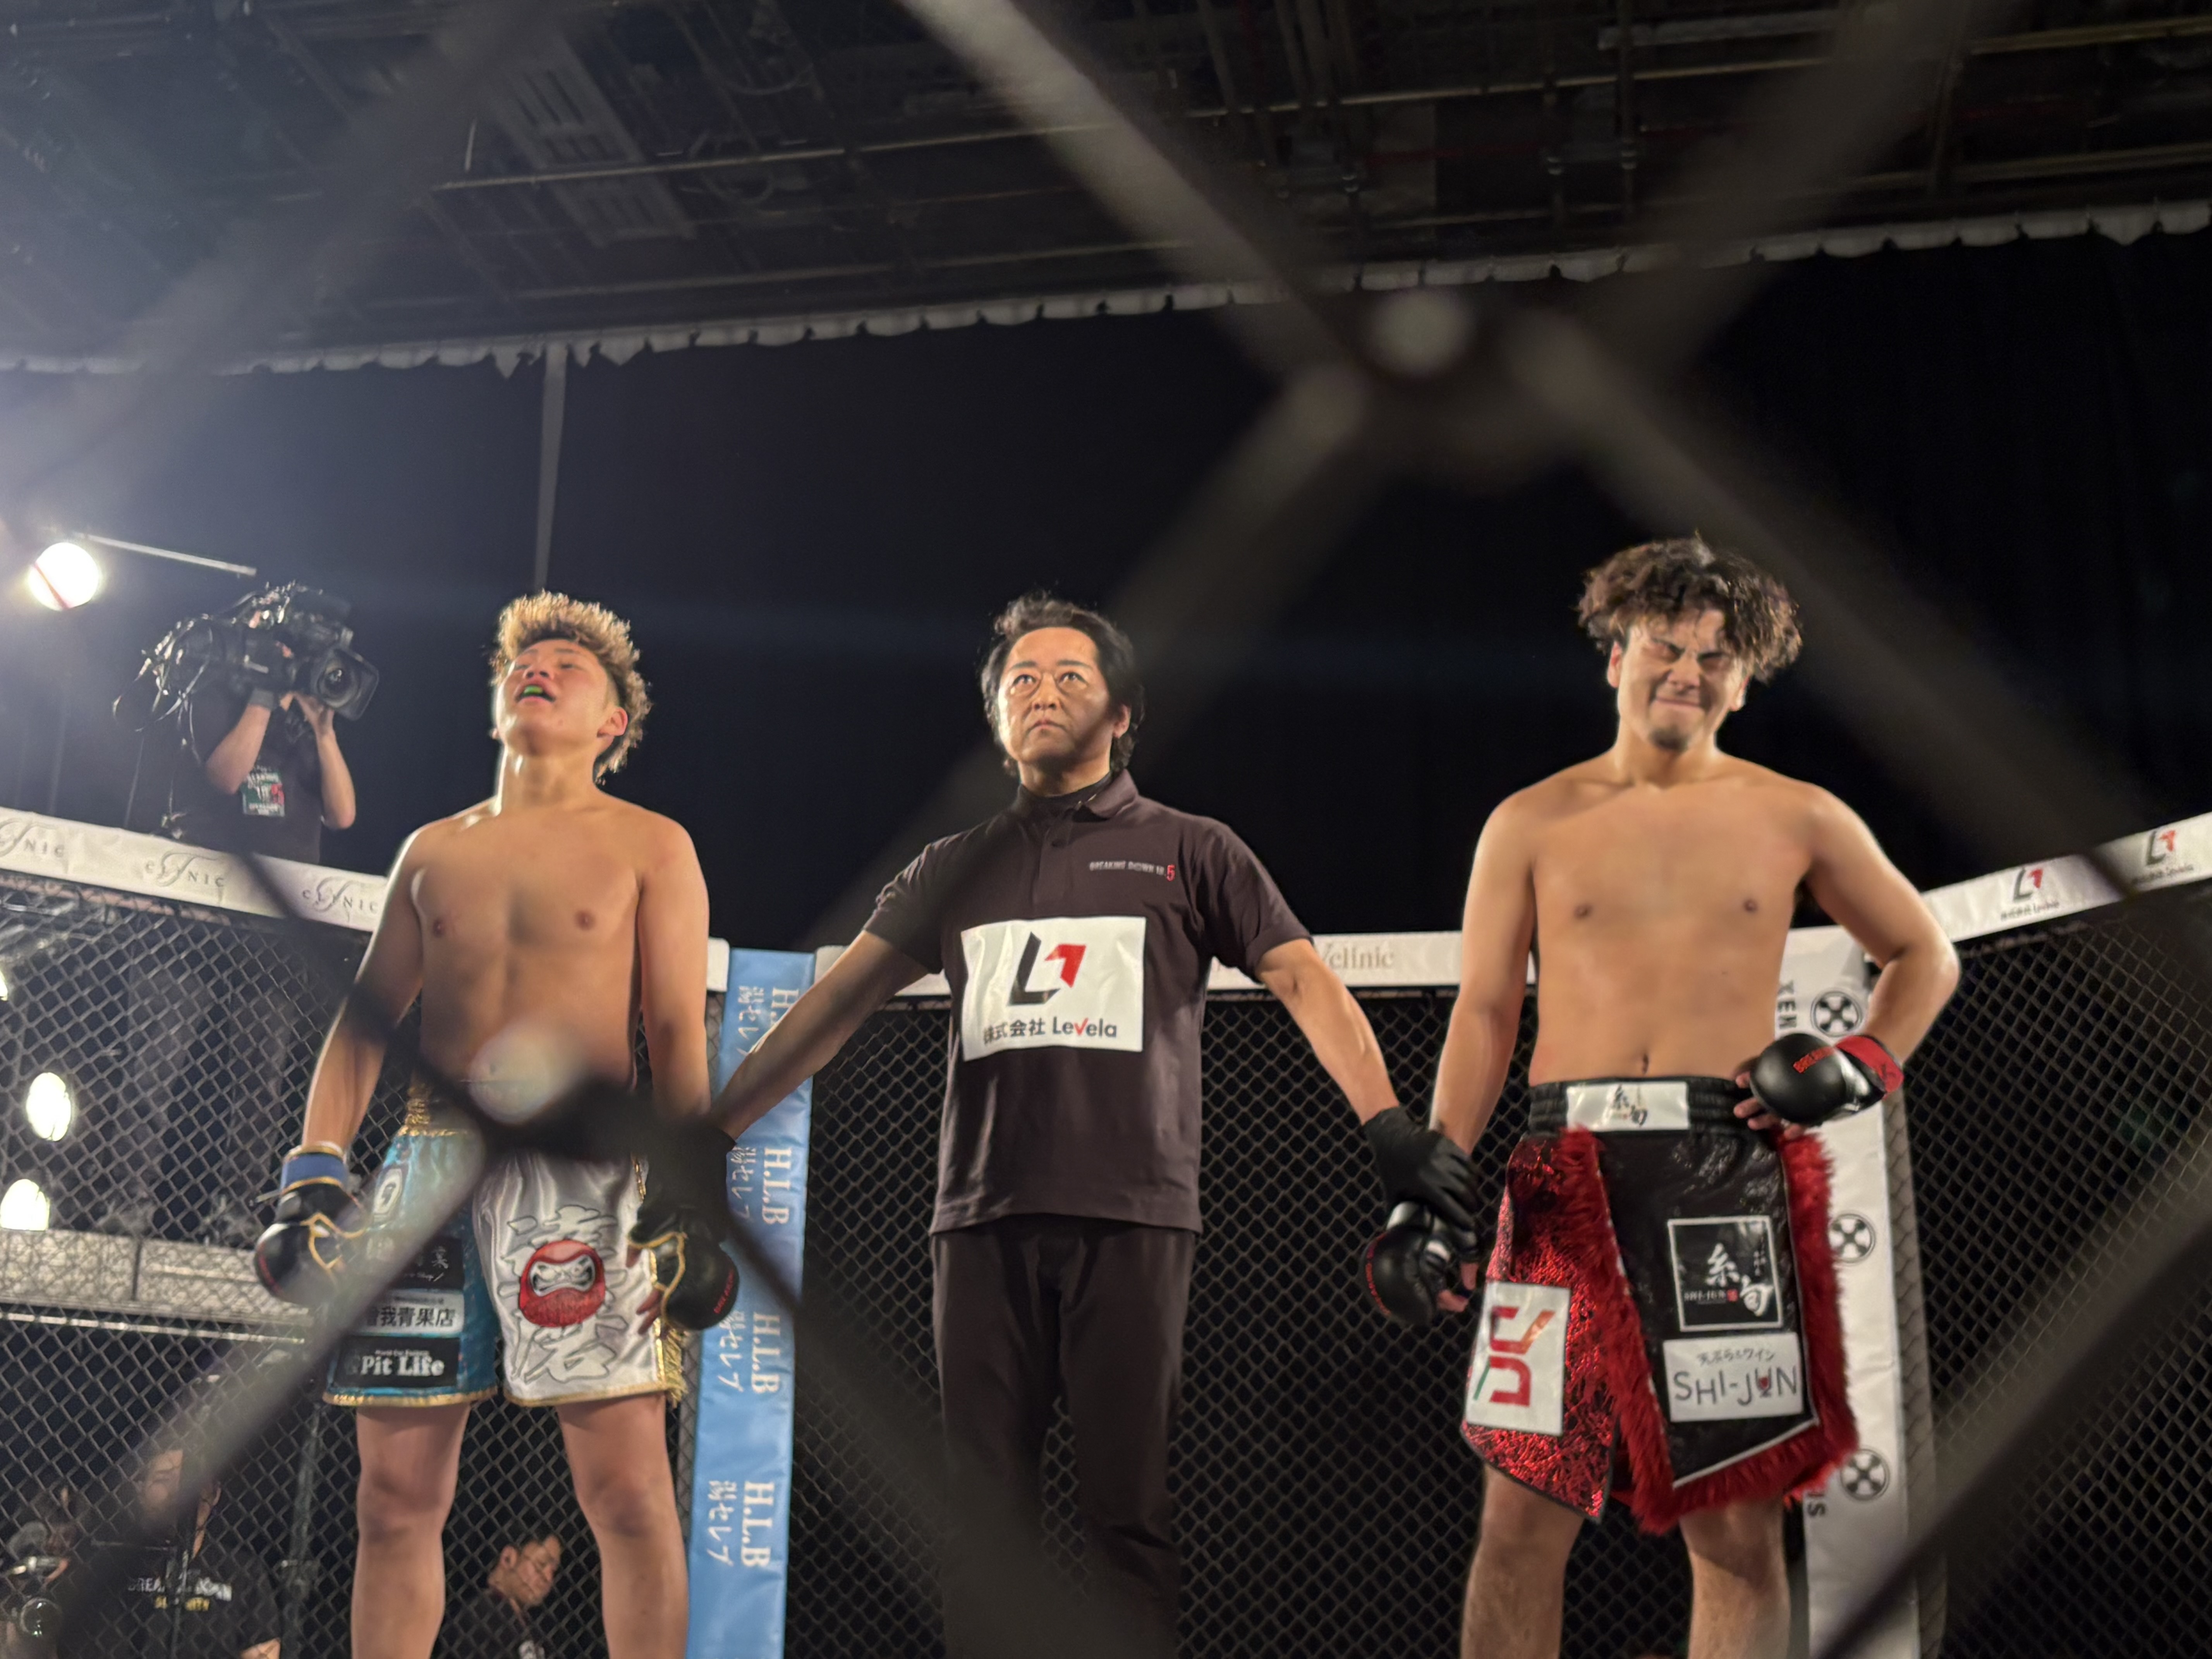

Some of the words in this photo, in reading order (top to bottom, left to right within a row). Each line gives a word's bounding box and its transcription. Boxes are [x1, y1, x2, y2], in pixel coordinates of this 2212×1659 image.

[984, 1017, 1046, 1045] 株式会社
[1053, 1016, 1117, 1038] Levela
[762, 1147, 792, 1225] H.L.B
[360, 1355, 393, 1376] Pit
[751, 1311, 781, 1394] H.L.B
[1673, 1365, 1798, 1407] SHI-JUN
[740, 1481, 775, 1568] H.L.B
